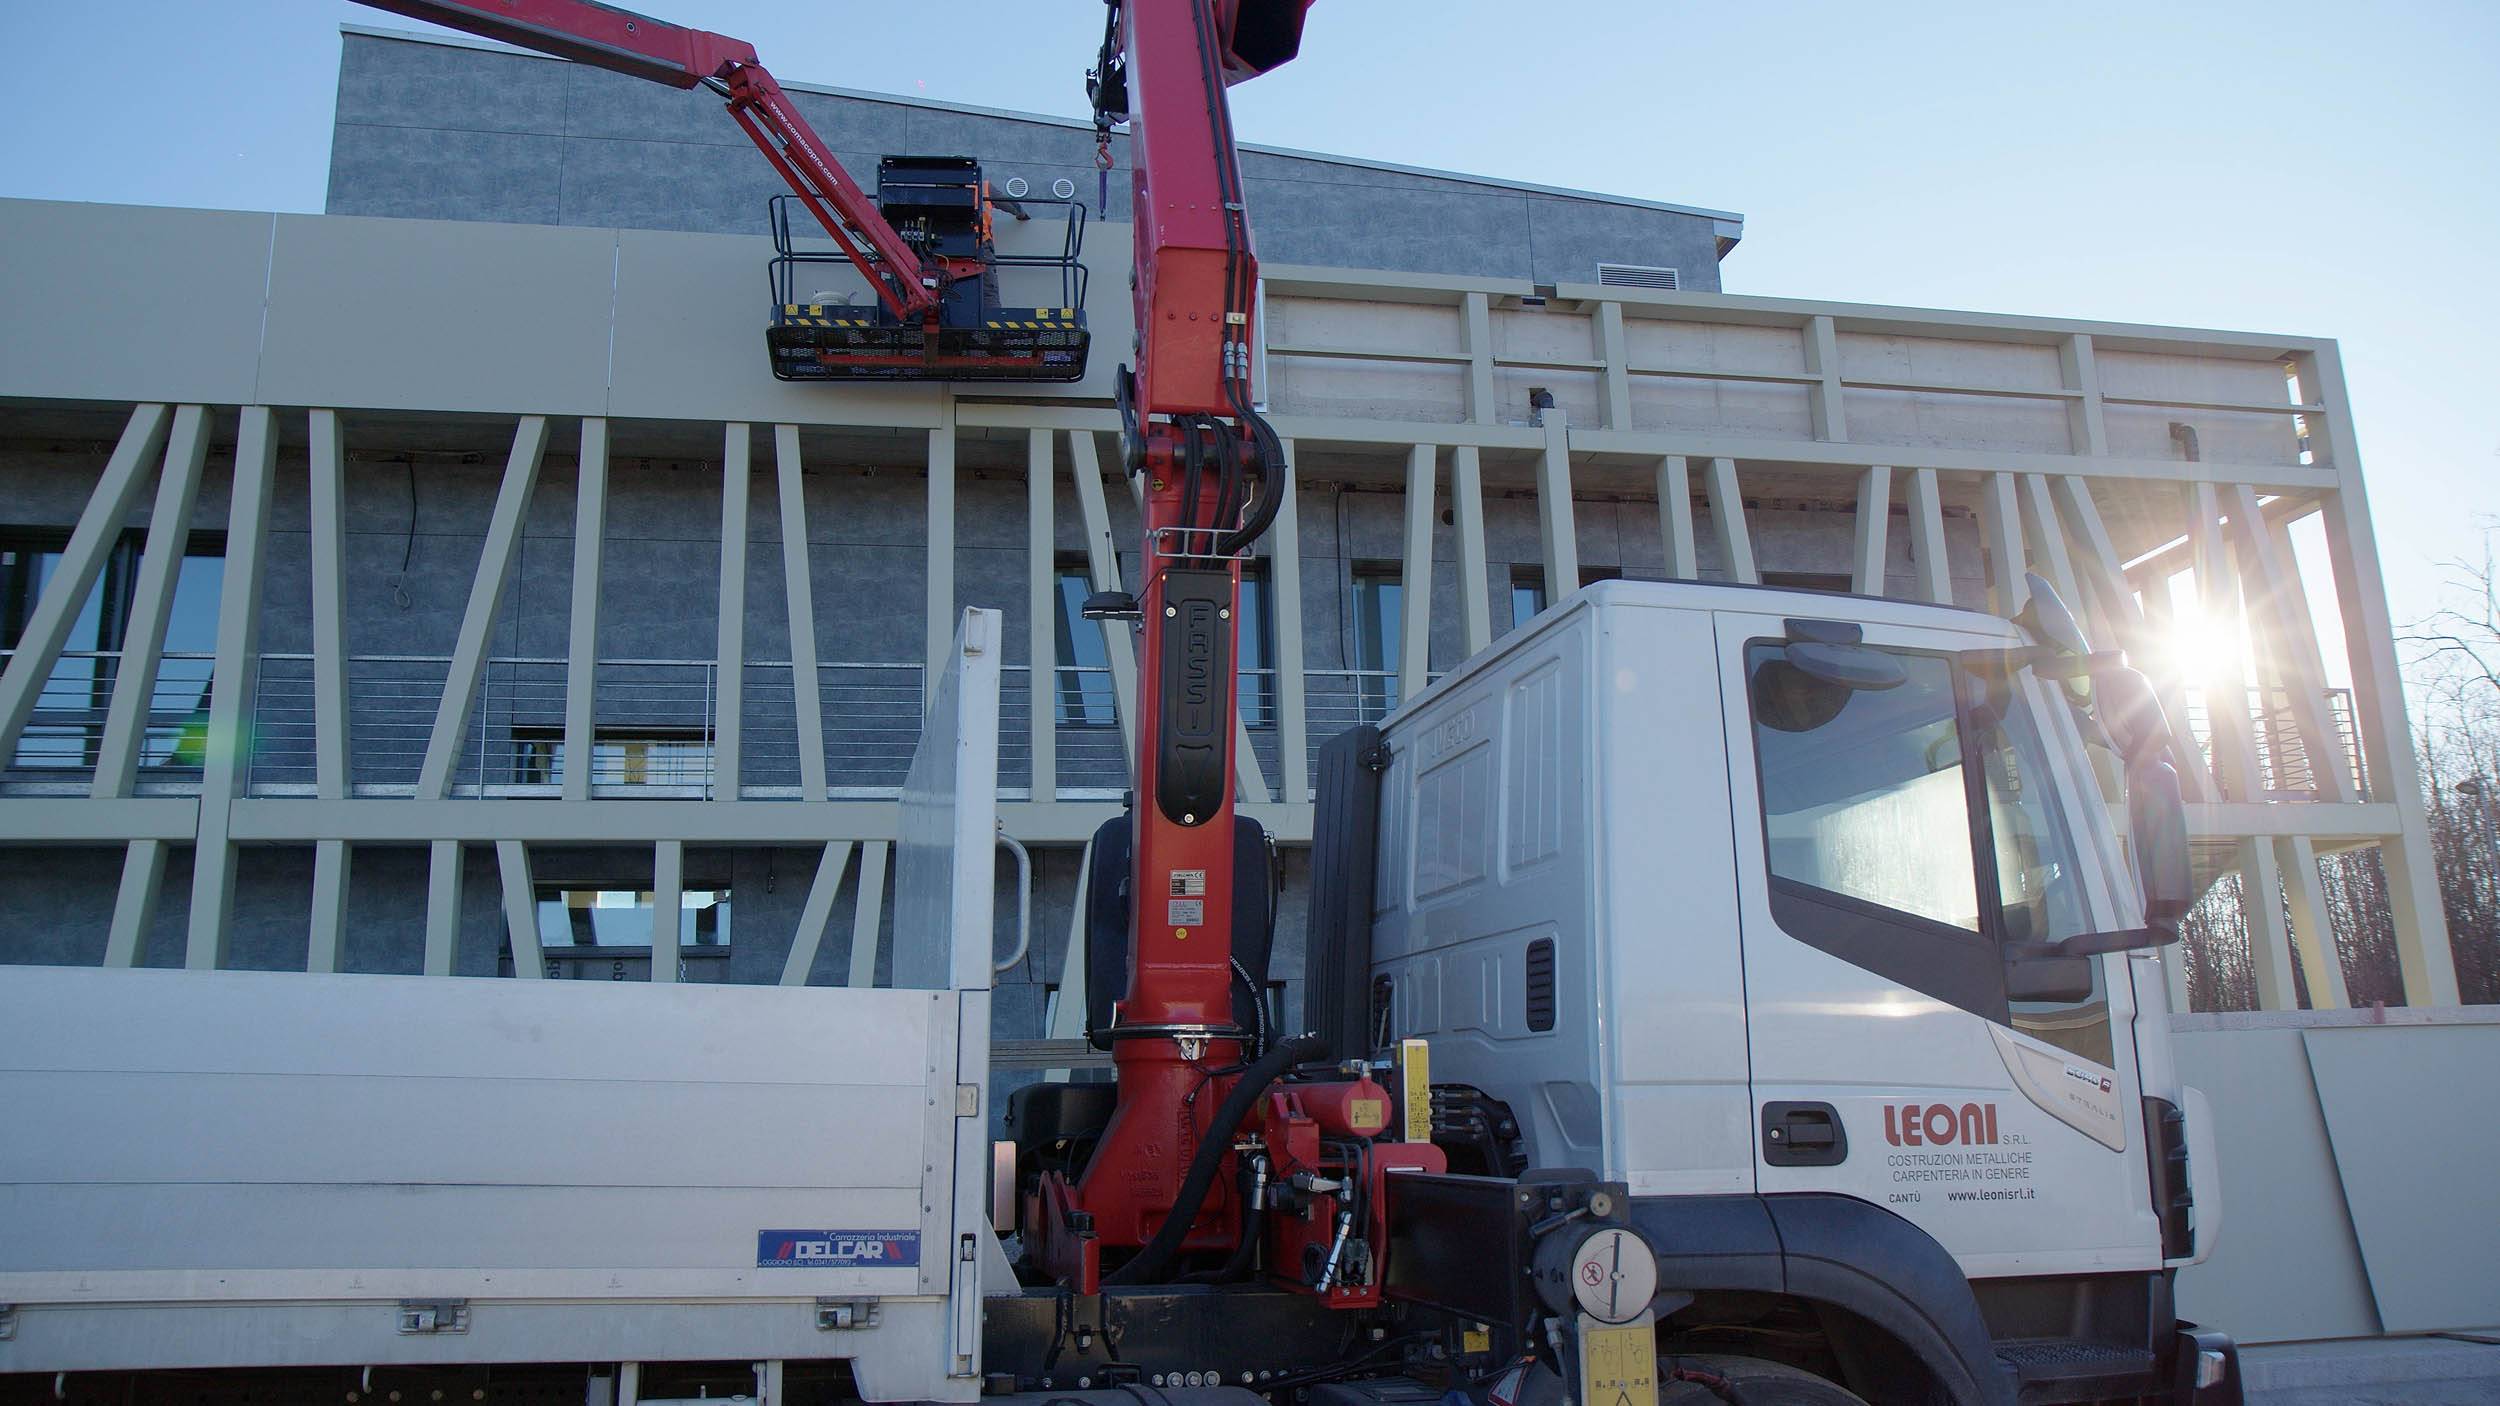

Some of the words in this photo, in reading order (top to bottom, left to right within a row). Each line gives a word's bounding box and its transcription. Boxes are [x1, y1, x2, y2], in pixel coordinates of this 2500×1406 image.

[770, 101, 838, 186] www.comacopro.com
[1884, 1103, 1998, 1147] LEONI
[2003, 1134, 2031, 1145] S.R.L.
[1887, 1154, 1963, 1167] COSTRUZIONI
[1966, 1152, 2033, 1165] METALLICHE
[1893, 1169, 1969, 1182] CARPENTERIA
[1972, 1168, 1983, 1180] IN
[1985, 1167, 2030, 1180] GENERE
[1888, 1190, 1921, 1203] CANTÙ
[1947, 1188, 2035, 1201] www.leonisrl.it
[829, 1232, 875, 1241] Carrozzeria
[876, 1232, 916, 1241] Industriale
[795, 1241, 884, 1259] DELCAR
